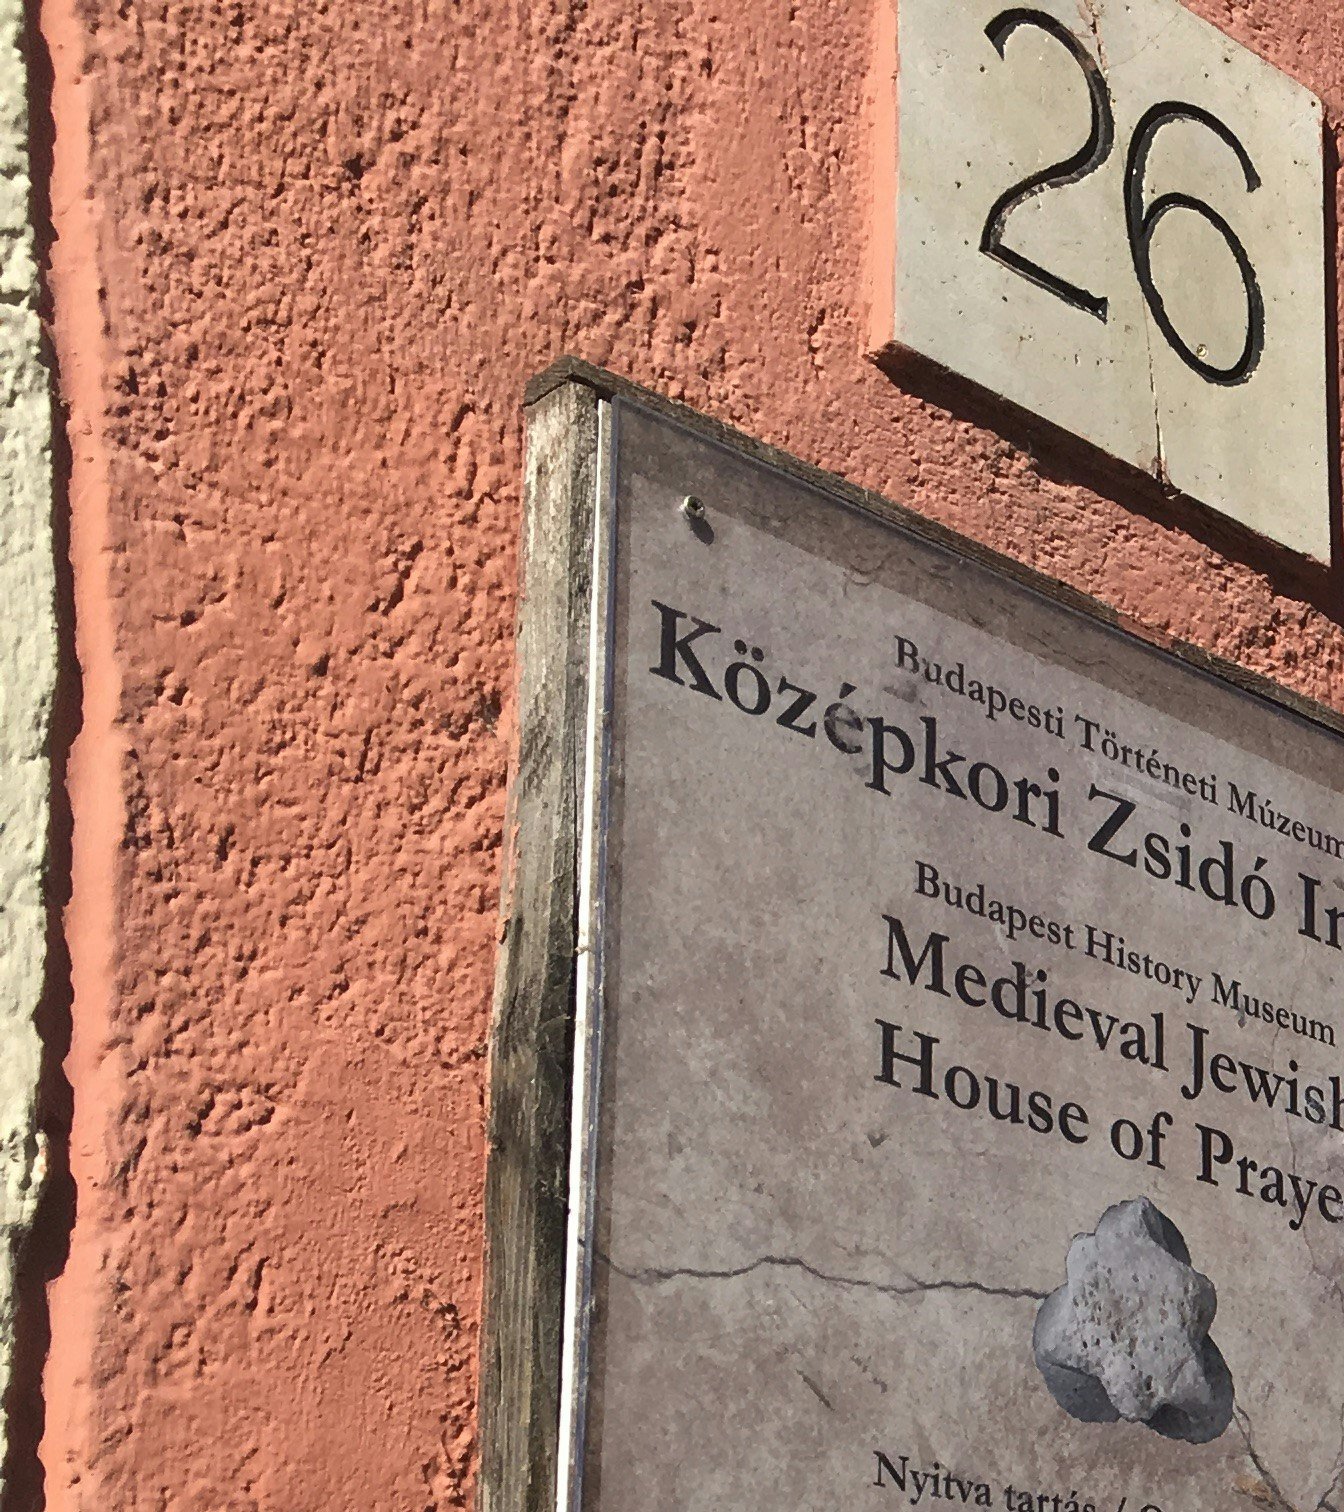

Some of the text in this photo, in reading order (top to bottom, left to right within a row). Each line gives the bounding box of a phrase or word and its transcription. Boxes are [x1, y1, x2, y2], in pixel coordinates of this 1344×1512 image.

[978, 8, 1265, 387] 26
[649, 601, 1065, 839] Középkori
[1086, 783, 1276, 922] Zsidó
[894, 636, 1066, 738] Budapesti
[1074, 714, 1219, 804] Történeti
[880, 914, 1168, 1073] Medieval
[915, 861, 1337, 1047] Budapest History Museum
[874, 1019, 1091, 1144] House
[1111, 1111, 1171, 1170] of
[873, 1450, 993, 1505] Nyitva
